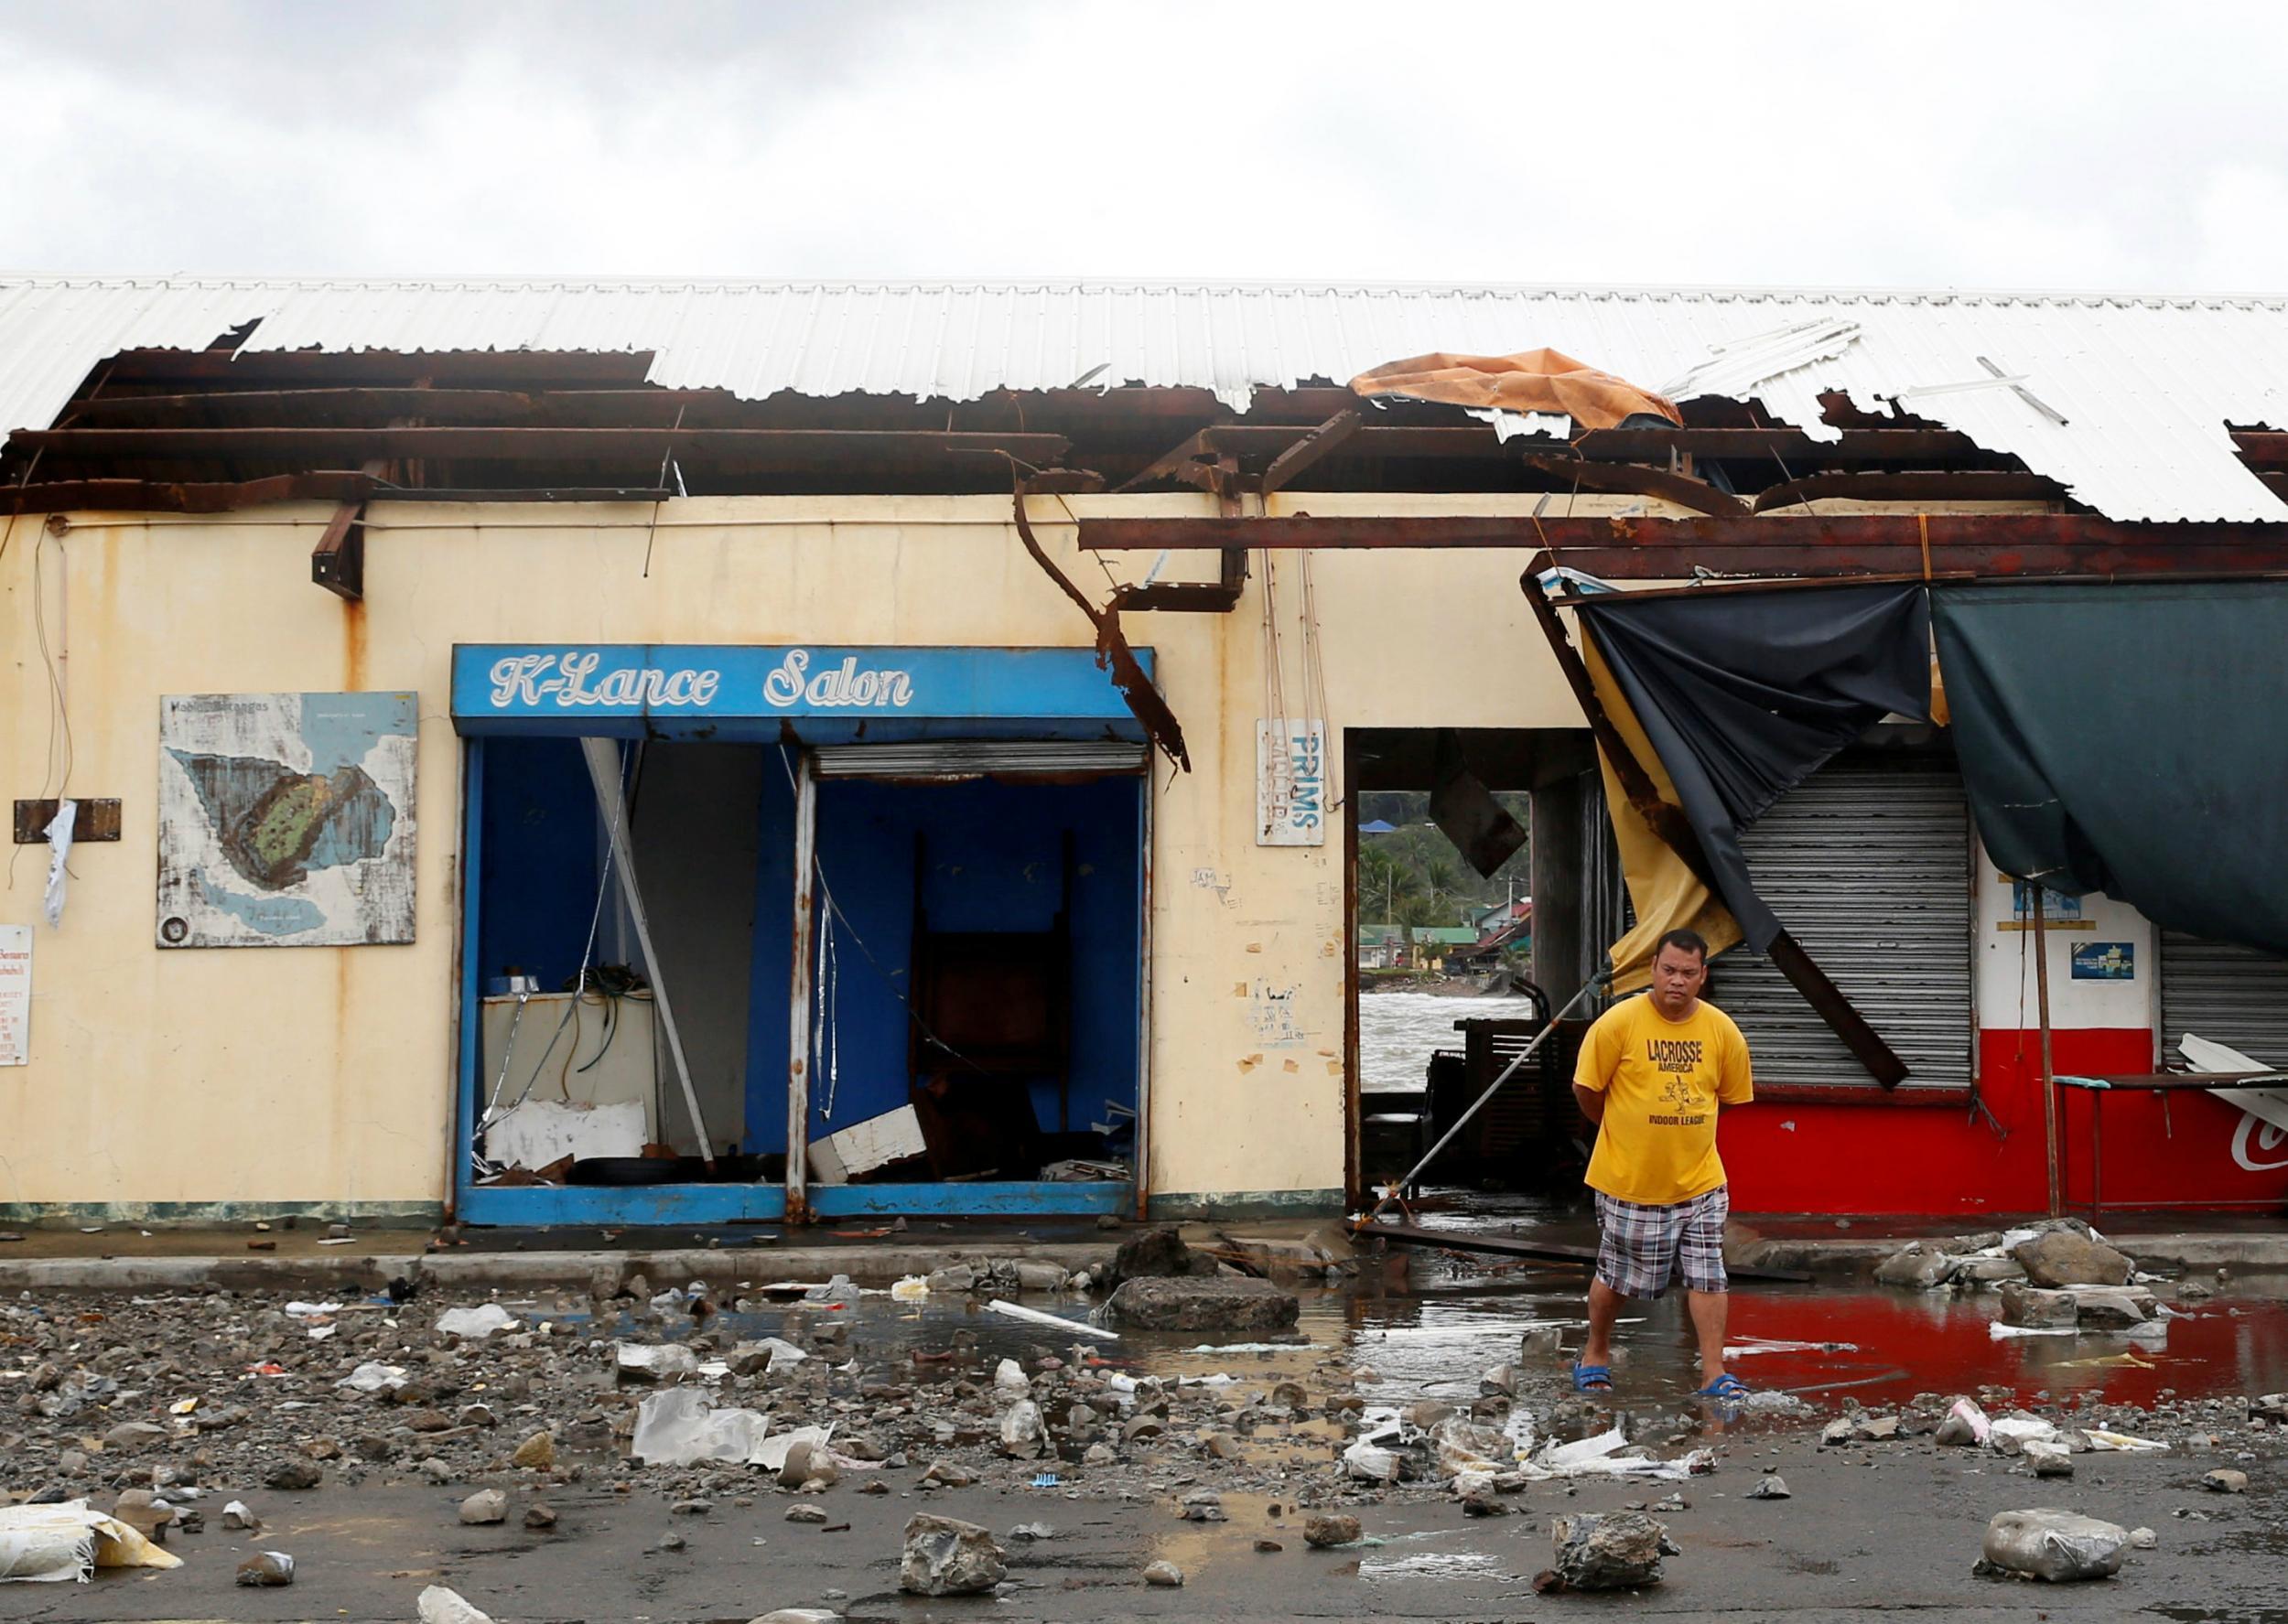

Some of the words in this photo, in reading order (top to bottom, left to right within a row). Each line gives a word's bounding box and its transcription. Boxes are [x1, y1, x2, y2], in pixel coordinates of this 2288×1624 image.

[491, 651, 720, 706] K-Lance
[763, 649, 913, 707] Salon
[1291, 737, 1320, 828] PRIMS
[1646, 1039, 1702, 1063] LACROSSE
[1658, 1062, 1694, 1073] AMERICA
[1649, 1114, 1679, 1126] INDOOR
[1681, 1114, 1705, 1126] LEAGUE
